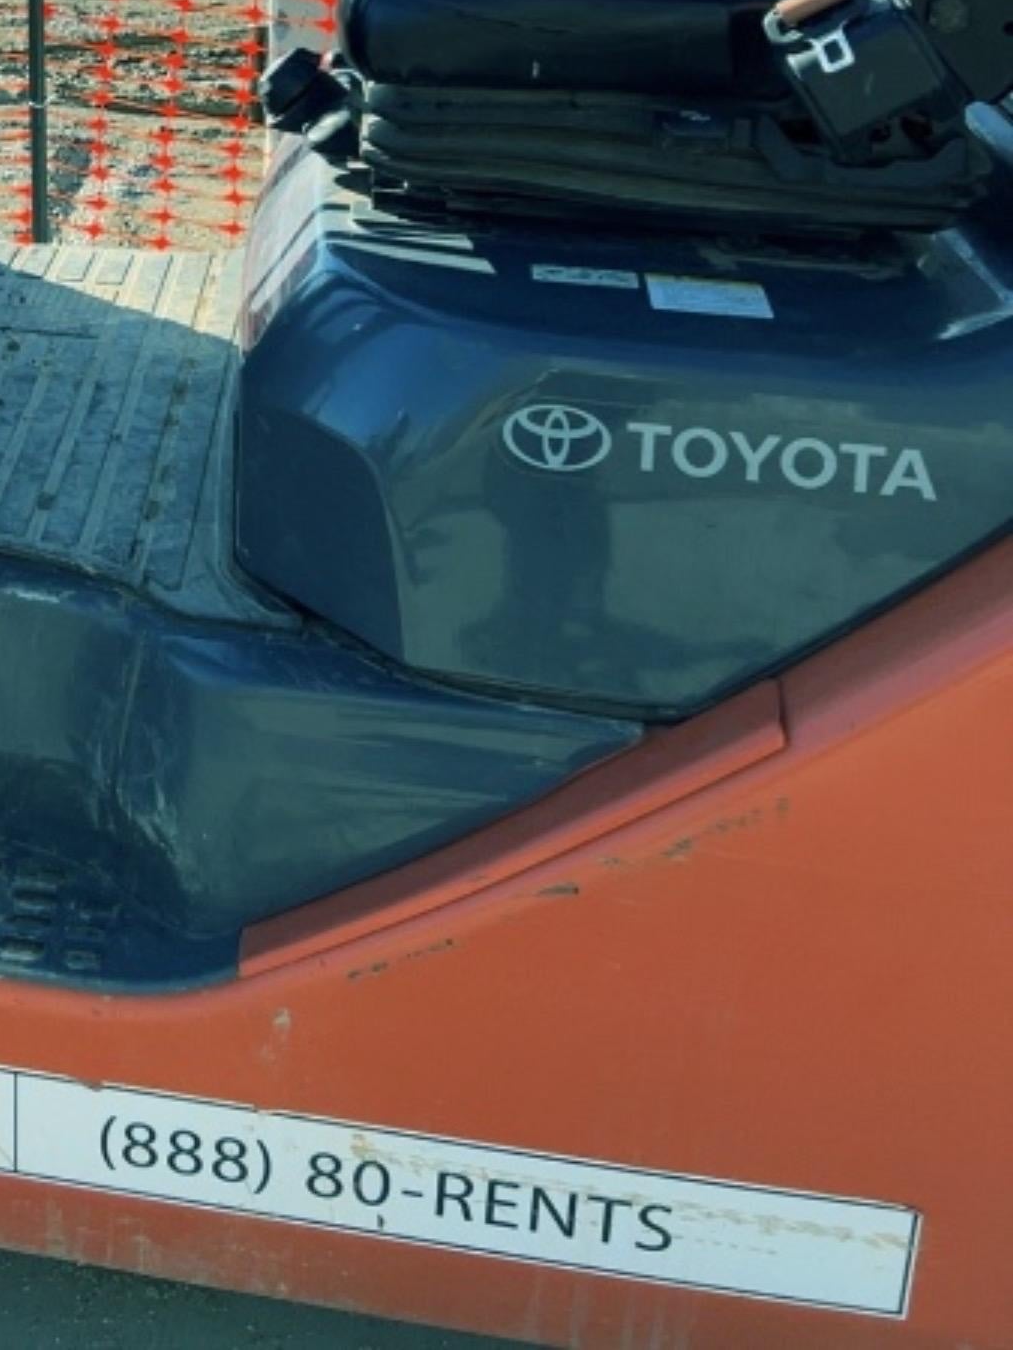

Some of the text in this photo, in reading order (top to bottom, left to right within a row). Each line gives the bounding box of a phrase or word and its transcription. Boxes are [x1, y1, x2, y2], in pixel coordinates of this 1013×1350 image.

[626, 421, 938, 502] TOYOTA
[98, 1115, 675, 1253] (888) 80-RENTS
